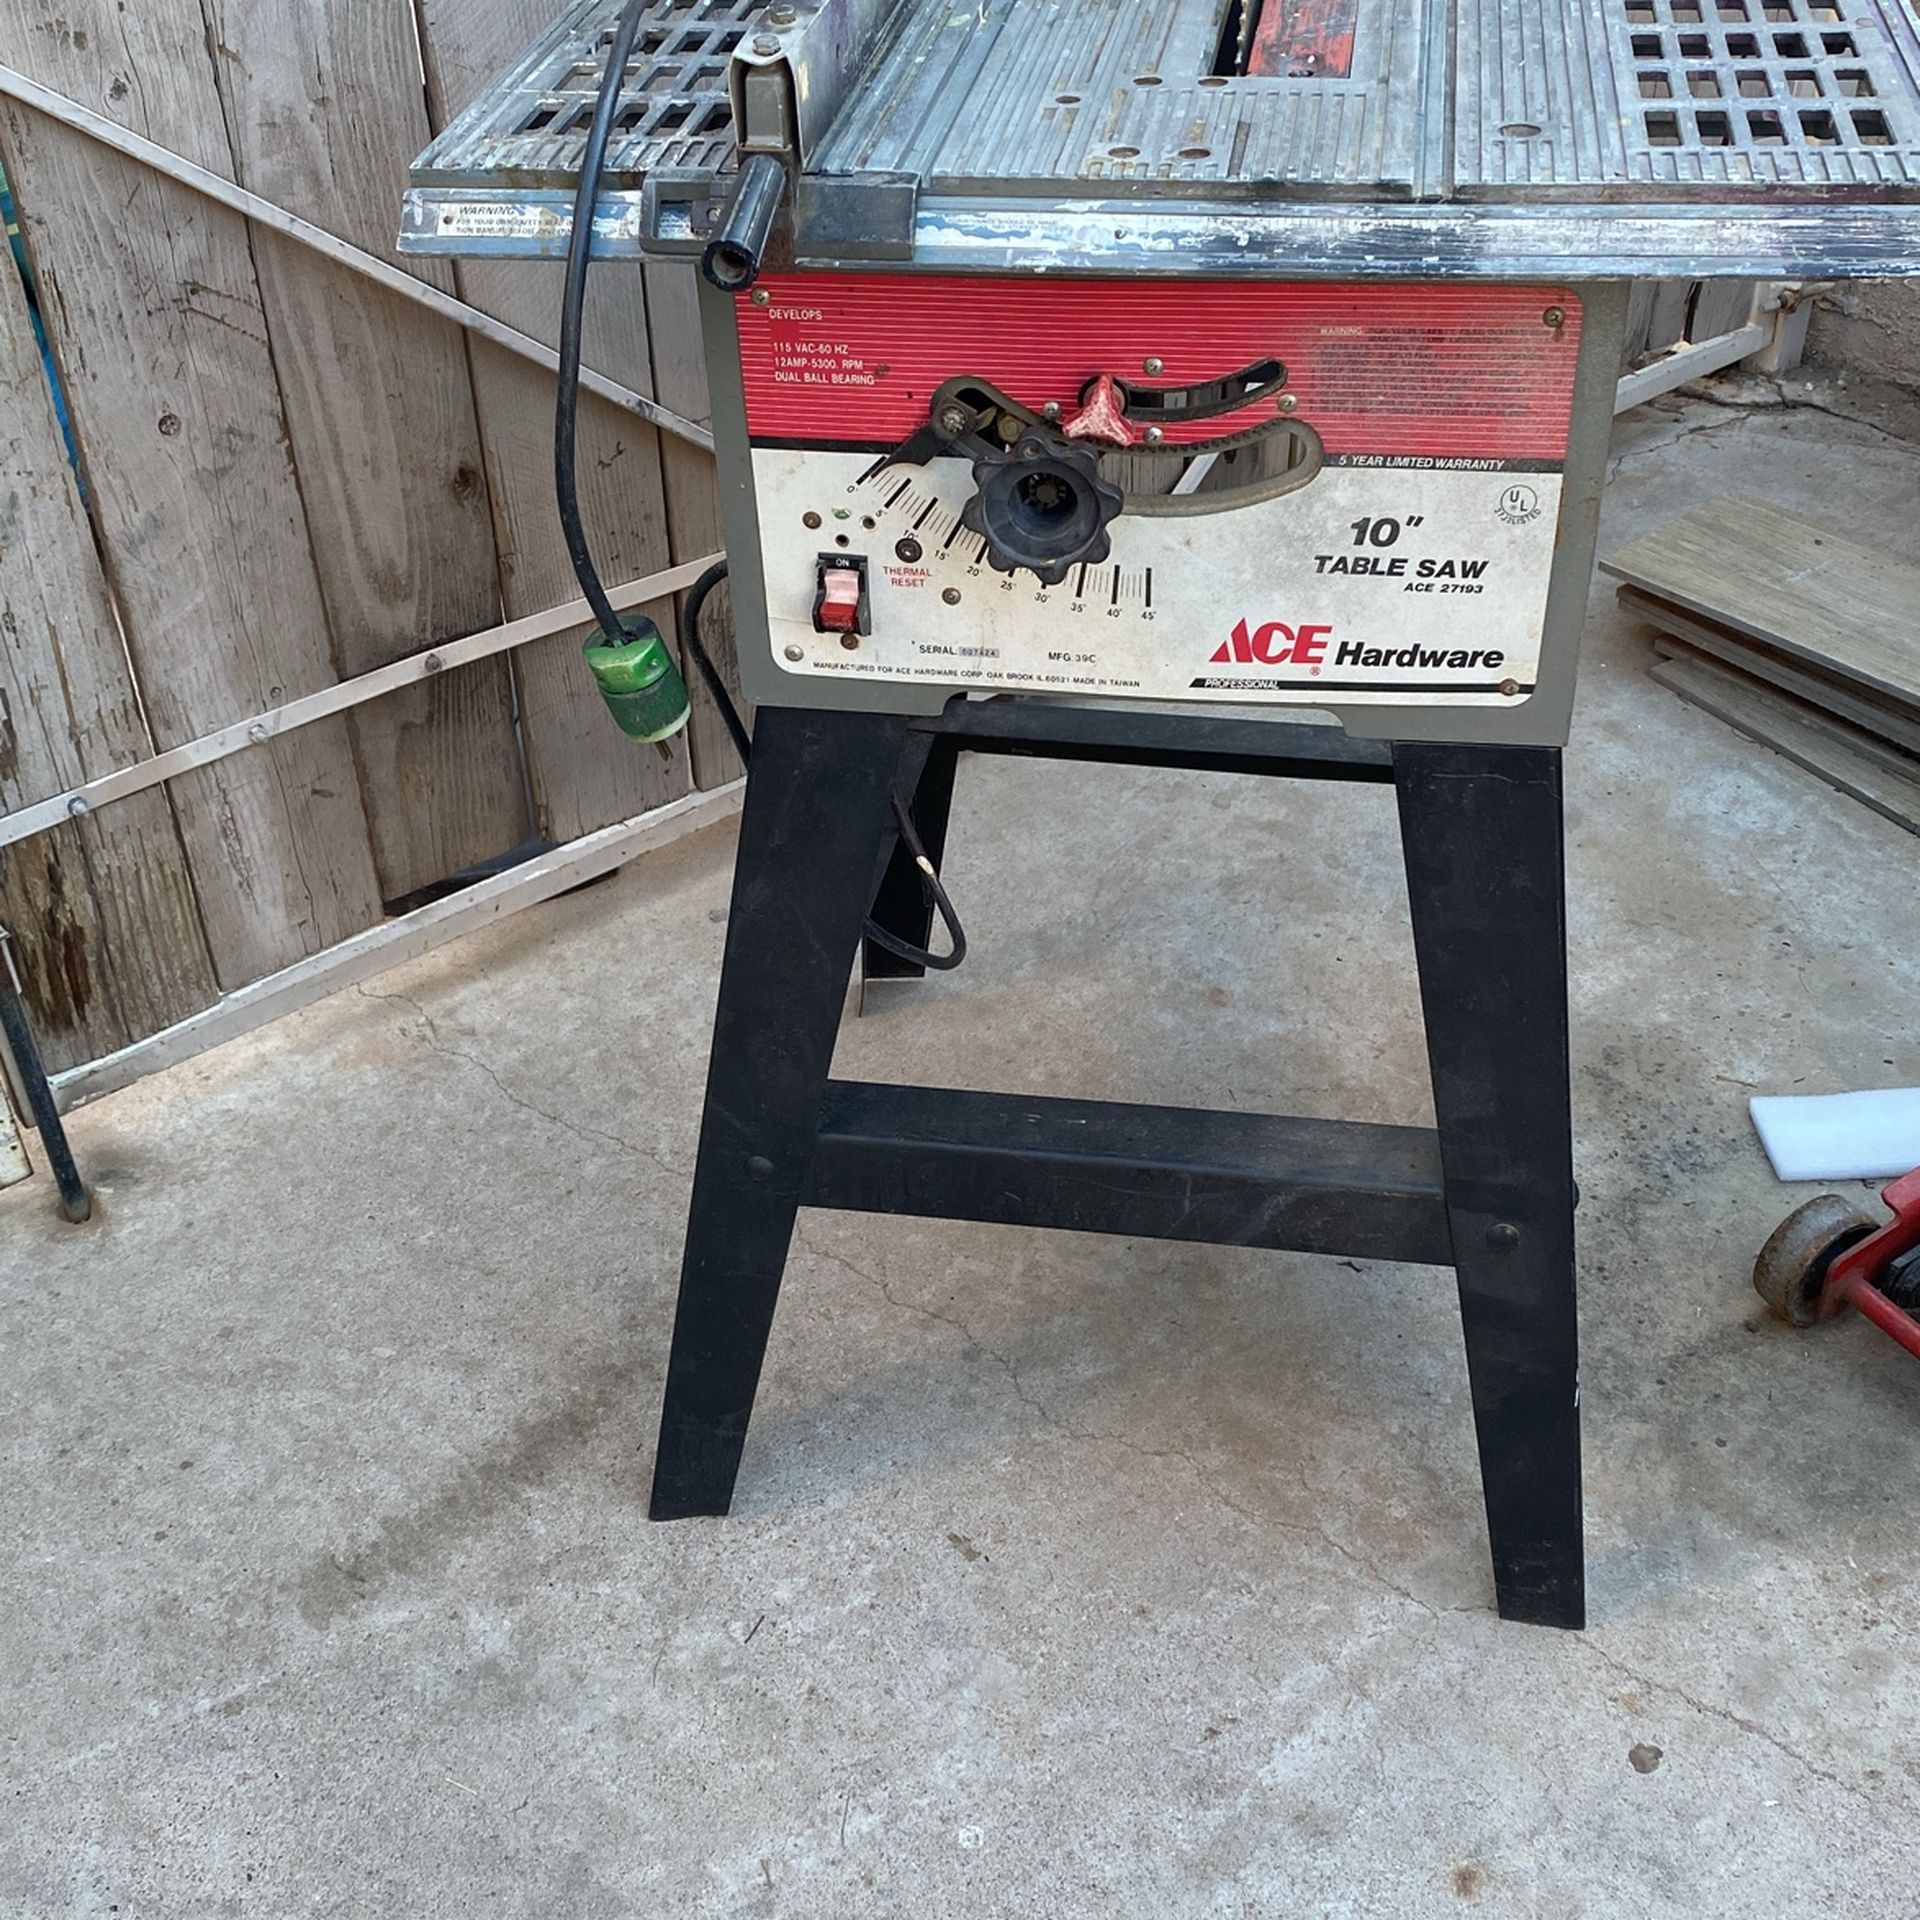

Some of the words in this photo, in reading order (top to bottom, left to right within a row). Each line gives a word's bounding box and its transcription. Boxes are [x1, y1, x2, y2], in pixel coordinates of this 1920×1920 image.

[459, 205, 515, 216] WARNING
[769, 308, 823, 321] DEVELOPS
[773, 342, 791, 353] 115
[795, 343, 831, 355] VAC-60
[835, 344, 849, 355] HZ
[842, 359, 864, 371] RPM
[774, 371, 801, 383] DUAL
[804, 373, 829, 384] BALL
[832, 374, 875, 386] BEARING
[1338, 456, 1347, 466] 5
[1351, 456, 1383, 467] YEAR
[1386, 457, 1433, 468] LIMITED
[1435, 460, 1505, 471] WARRANTY
[1350, 515, 1424, 547] 10"
[835, 558, 850, 567] ON
[1314, 555, 1408, 577] TABLE
[1415, 559, 1490, 580] SAW
[883, 566, 933, 578] THERMAL
[891, 578, 926, 588] RESET
[1403, 582, 1435, 593] ACE
[1439, 584, 1484, 595] 27193
[1209, 617, 1333, 665] ACE
[1334, 641, 1505, 670] Hardware
[813, 661, 876, 673] MANUFACTURED
[877, 666, 893, 674] FOR
[896, 667, 911, 675] ACE
[914, 668, 958, 678] HARDWARE
[986, 670, 1004, 680] OAK
[1006, 672, 1034, 682] BROOK
[1073, 677, 1095, 685] MADE
[1110, 679, 1141, 688] TAIWAN
[1204, 678, 1279, 691] PROFESSIONAL
